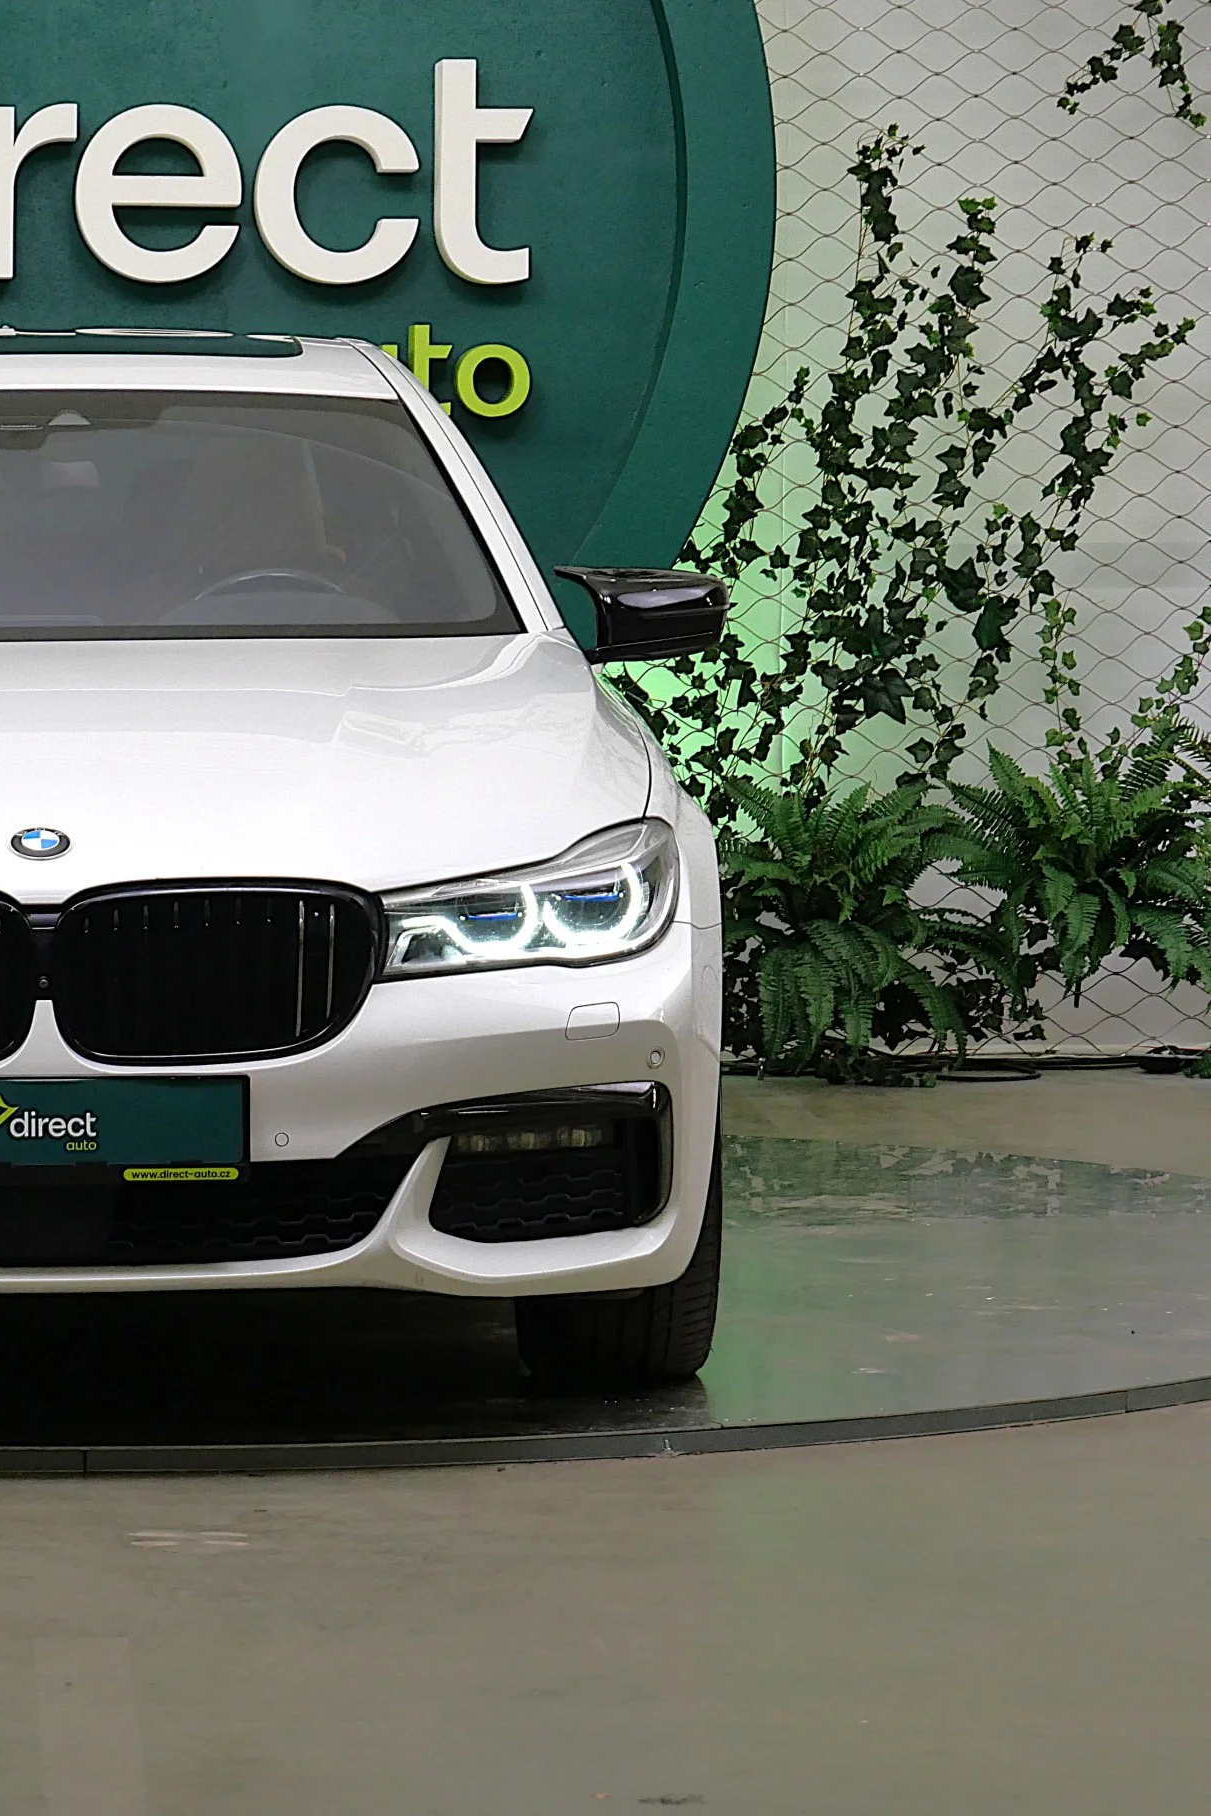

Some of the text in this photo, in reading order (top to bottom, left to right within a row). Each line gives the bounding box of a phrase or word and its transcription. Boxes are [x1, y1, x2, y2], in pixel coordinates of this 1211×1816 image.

[9, 1111, 97, 1138] direct
[66, 1140, 97, 1151] auto
[131, 1169, 231, 1179] www.direct-auto.cz
